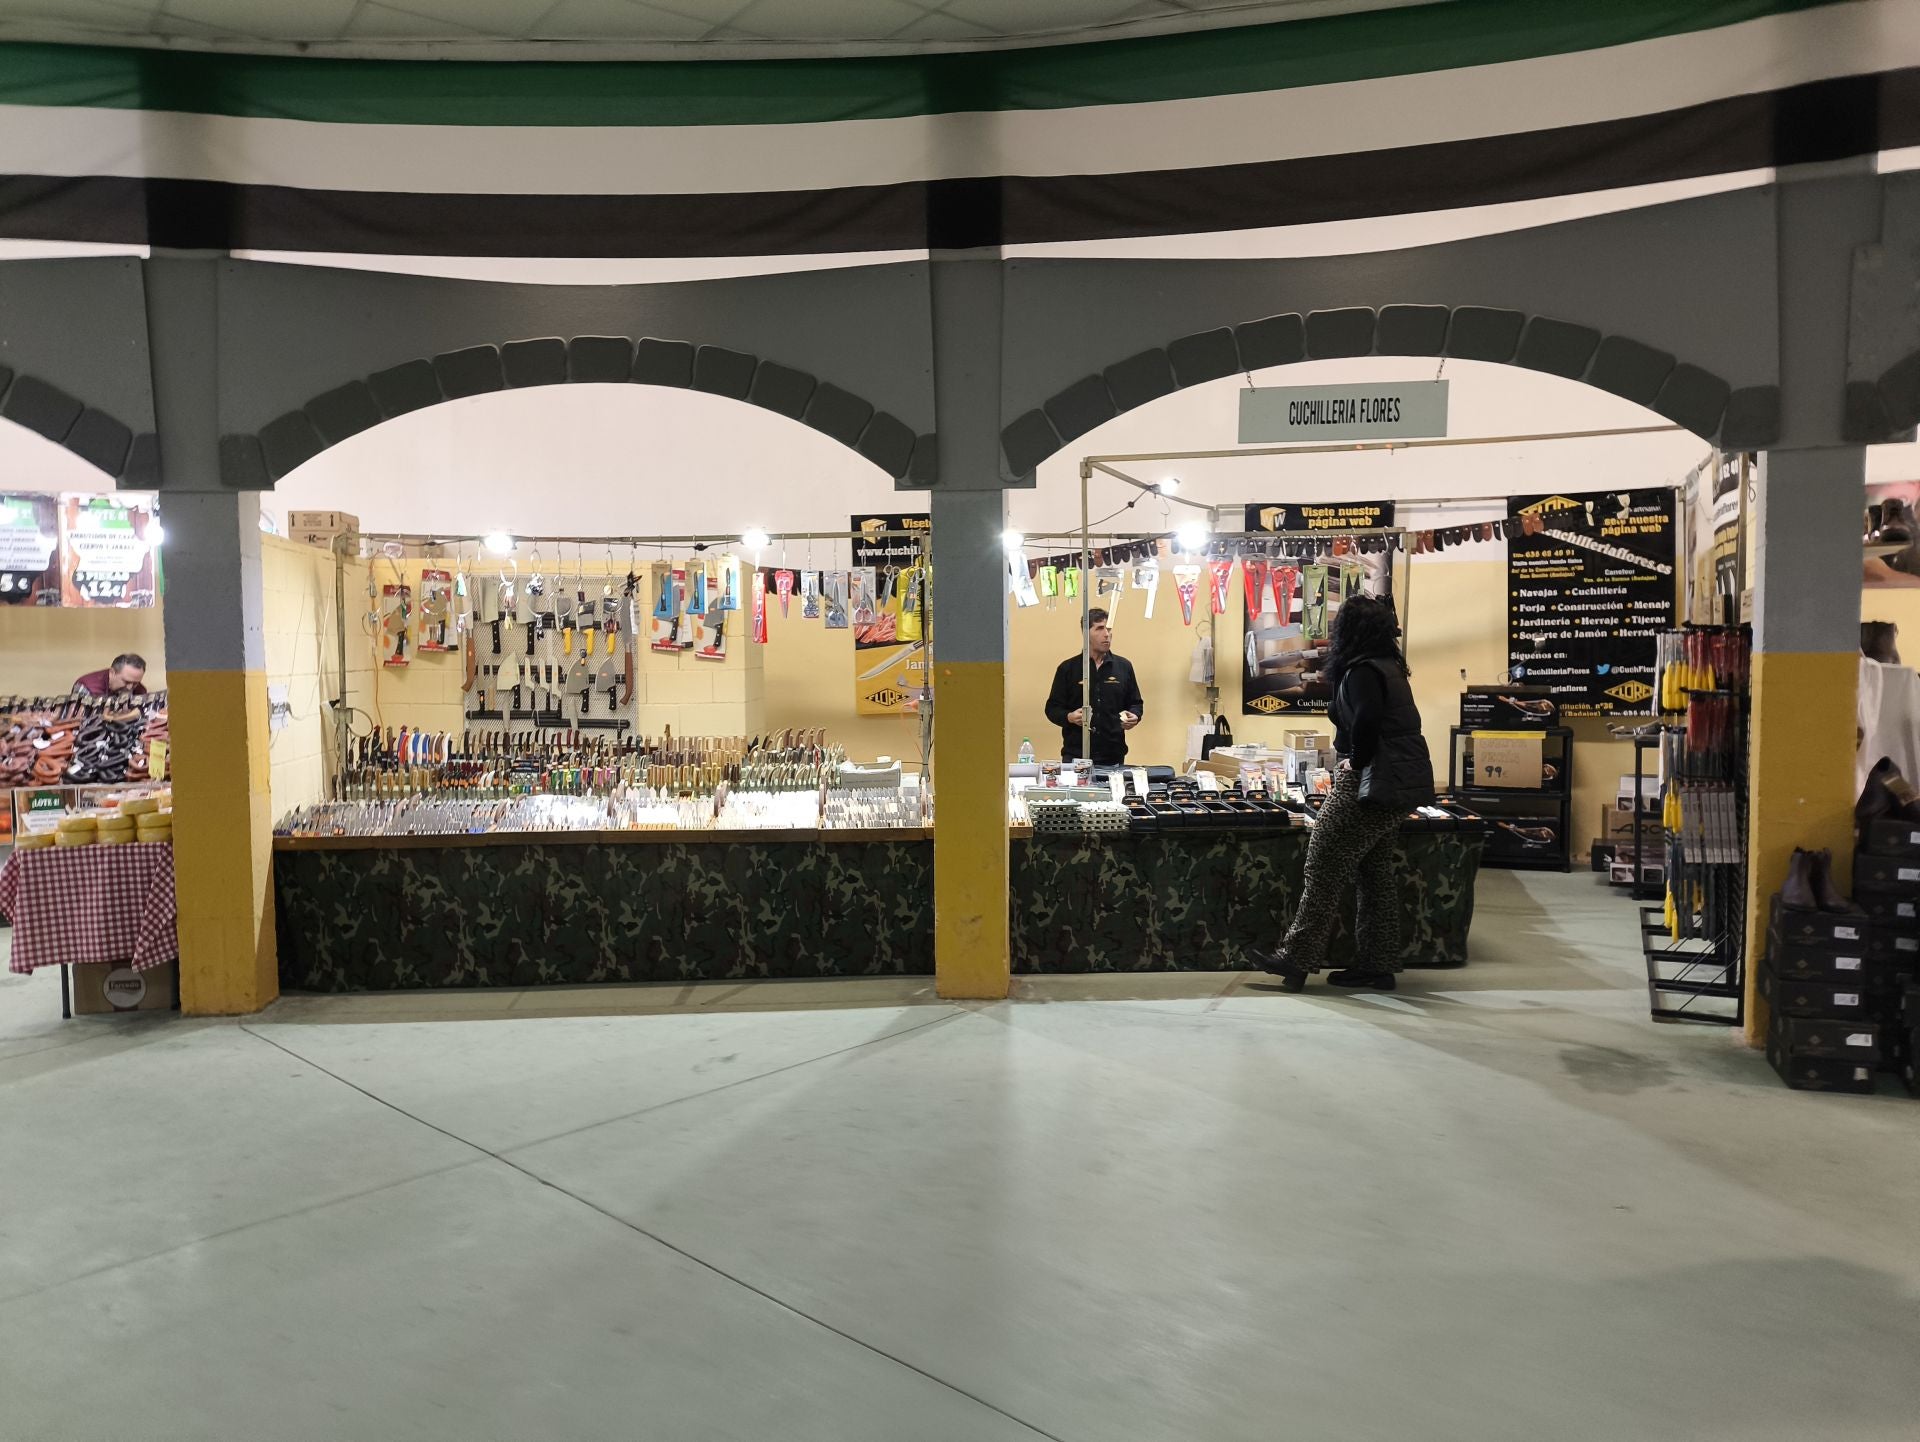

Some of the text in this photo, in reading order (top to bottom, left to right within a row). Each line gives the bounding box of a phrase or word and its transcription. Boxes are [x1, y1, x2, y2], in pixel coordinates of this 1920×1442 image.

[1289, 397, 1401, 426] CUCHILLERIA FLORES
[1302, 506, 1381, 517] Visete nuestra
[1308, 515, 1373, 529] página web
[1629, 514, 1669, 525] nuestra
[1601, 523, 1662, 537] página web
[1519, 587, 1628, 598] Navajas Cuchillería
[1519, 600, 1671, 613] Forja Construcción Menaje
[1519, 615, 1666, 627] Jardinería Herraje Tijeras
[1519, 628, 1655, 640] Sorte de Jamón Herrad
[1297, 698, 1331, 707] Cuchiller
